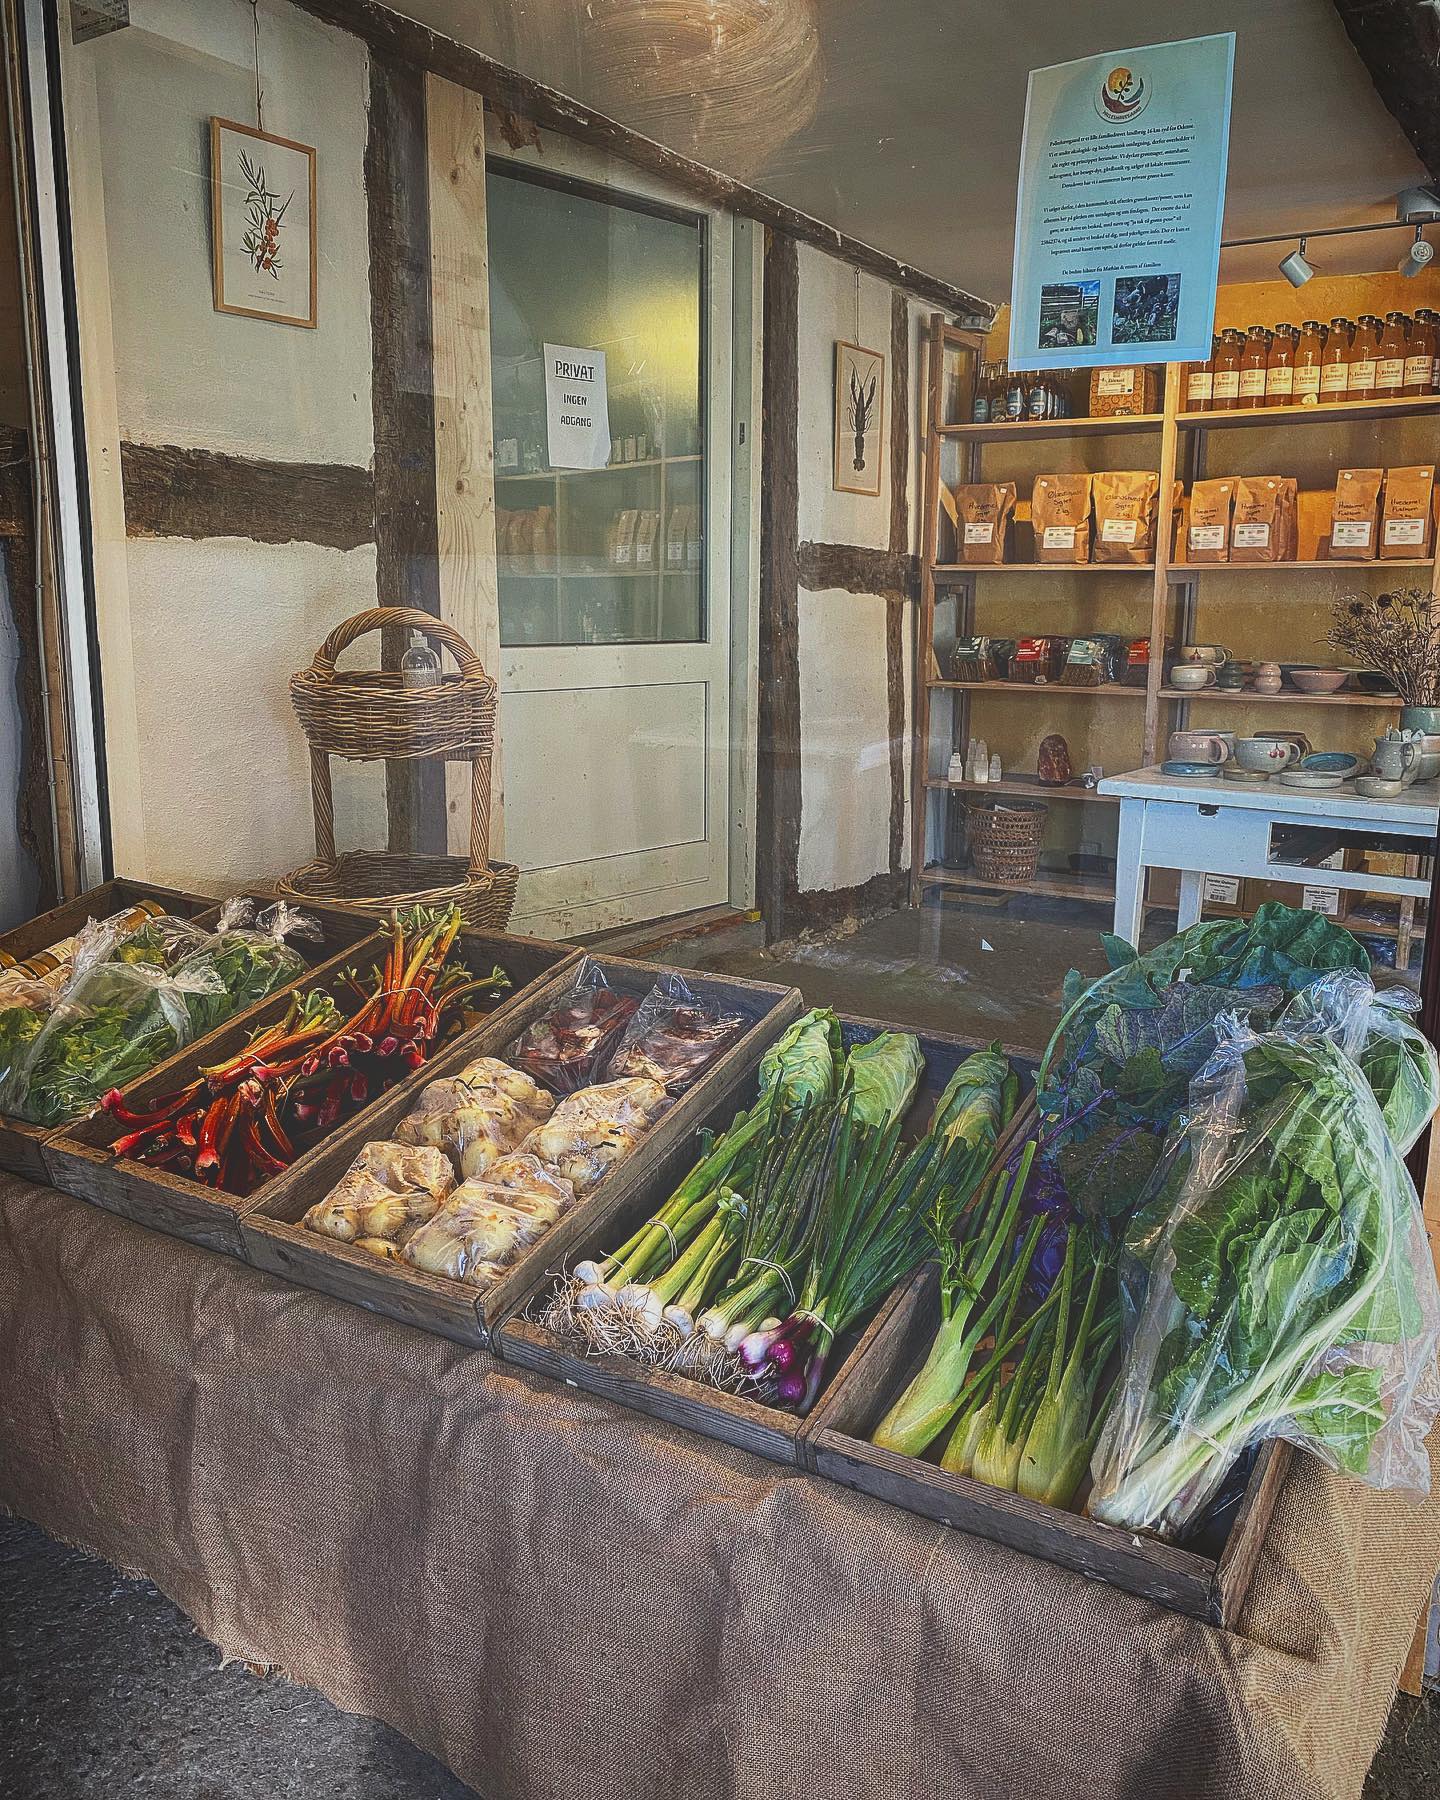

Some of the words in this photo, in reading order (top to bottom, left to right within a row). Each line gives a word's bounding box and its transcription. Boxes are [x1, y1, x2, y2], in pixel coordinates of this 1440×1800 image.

[555, 360, 595, 379] PRIVAT
[563, 393, 587, 406] INGEN
[560, 415, 592, 427] ADGANG
